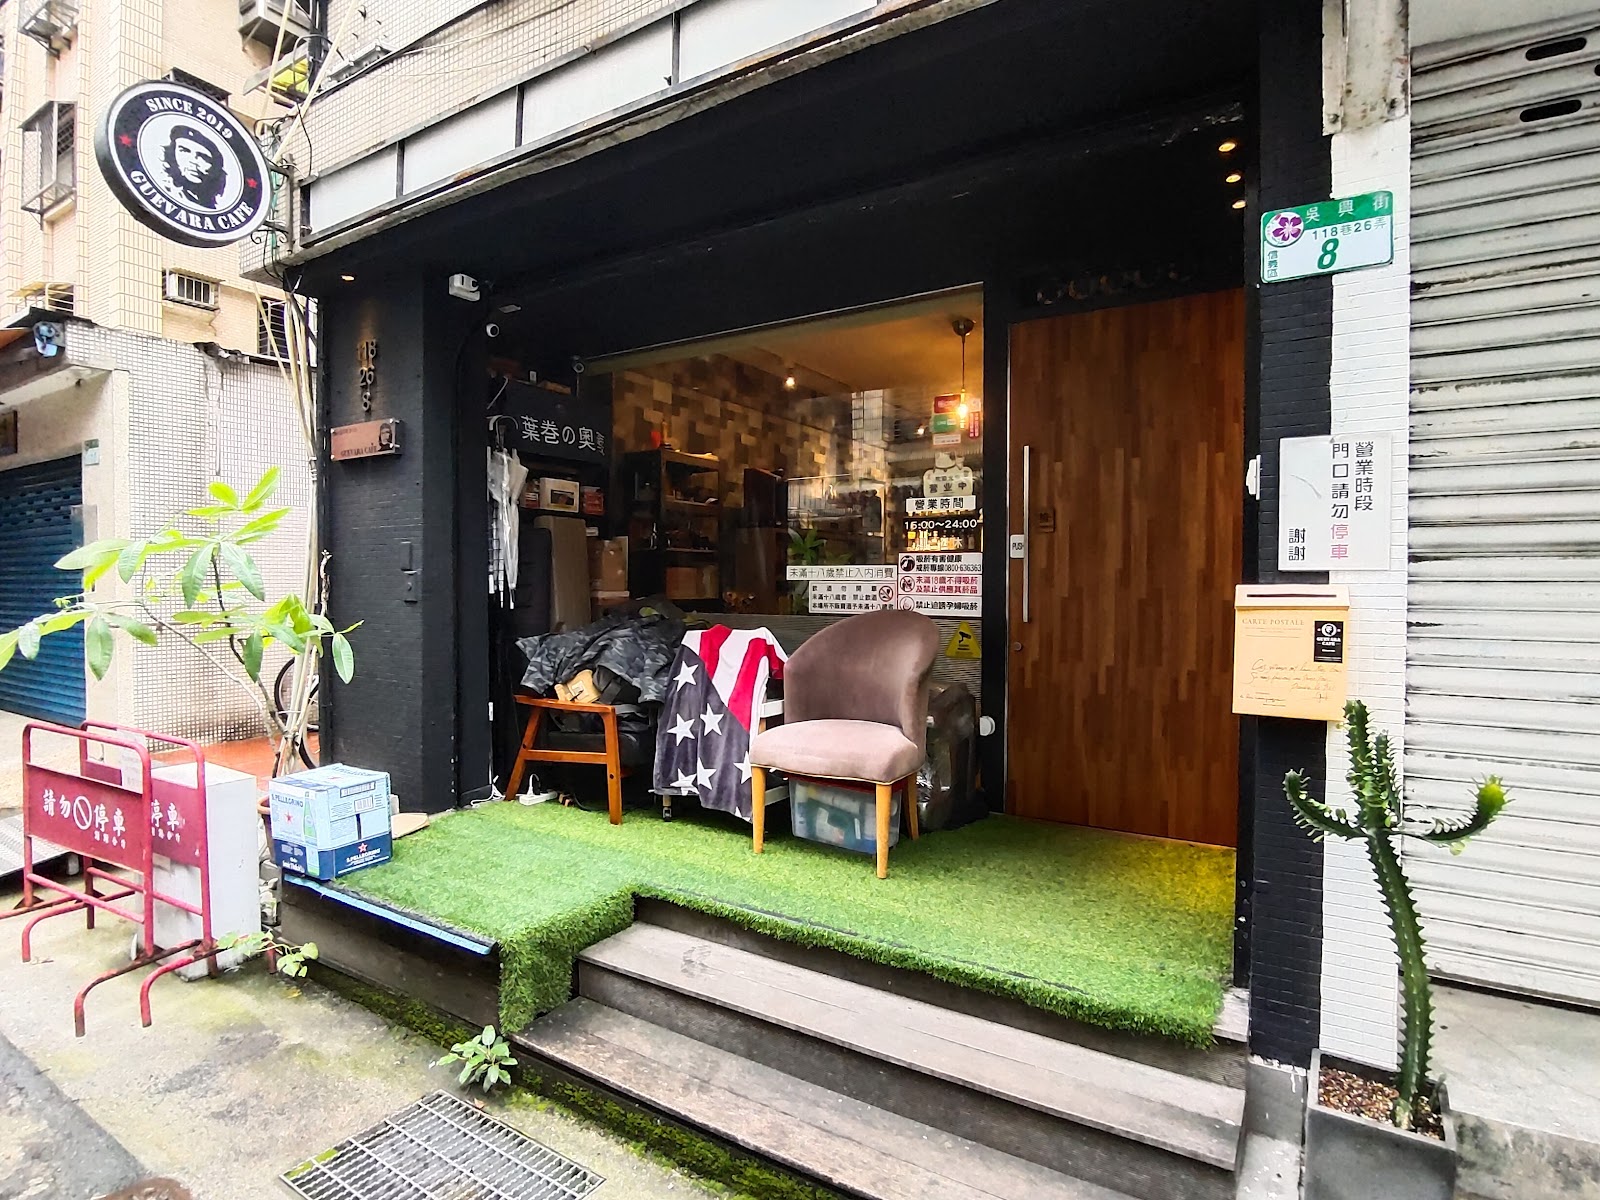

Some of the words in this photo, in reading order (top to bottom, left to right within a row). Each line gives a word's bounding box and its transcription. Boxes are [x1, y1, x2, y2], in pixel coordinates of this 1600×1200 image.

[145, 97, 194, 114] SINCE
[196, 106, 234, 140] 2019
[129, 169, 215, 232] GUEVARA
[217, 200, 254, 231] CAFE
[1305, 192, 1390, 224] 吳興街
[1312, 216, 1387, 240] 118巷26弄
[1267, 249, 1279, 279] 信義區
[1317, 237, 1340, 270] 8
[359, 367, 375, 387] 26
[362, 391, 372, 412] 8
[1354, 441, 1374, 512] 營業時段
[914, 497, 964, 510] 營業時間
[1330, 442, 1350, 560] 門口請勿停車
[1288, 527, 1306, 561] 謝謝
[916, 555, 963, 563] 吸菸有害健康
[789, 567, 894, 579] 未滿十八歲禁止入內消費
[916, 576, 978, 585] 未滿18歲不得吸菸
[915, 585, 978, 594] 及禁止供應其菸品
[1241, 618, 1268, 626] CARTE
[1270, 618, 1305, 626] POSTALE
[42, 788, 71, 819] 請勿
[93, 803, 126, 837] 停車
